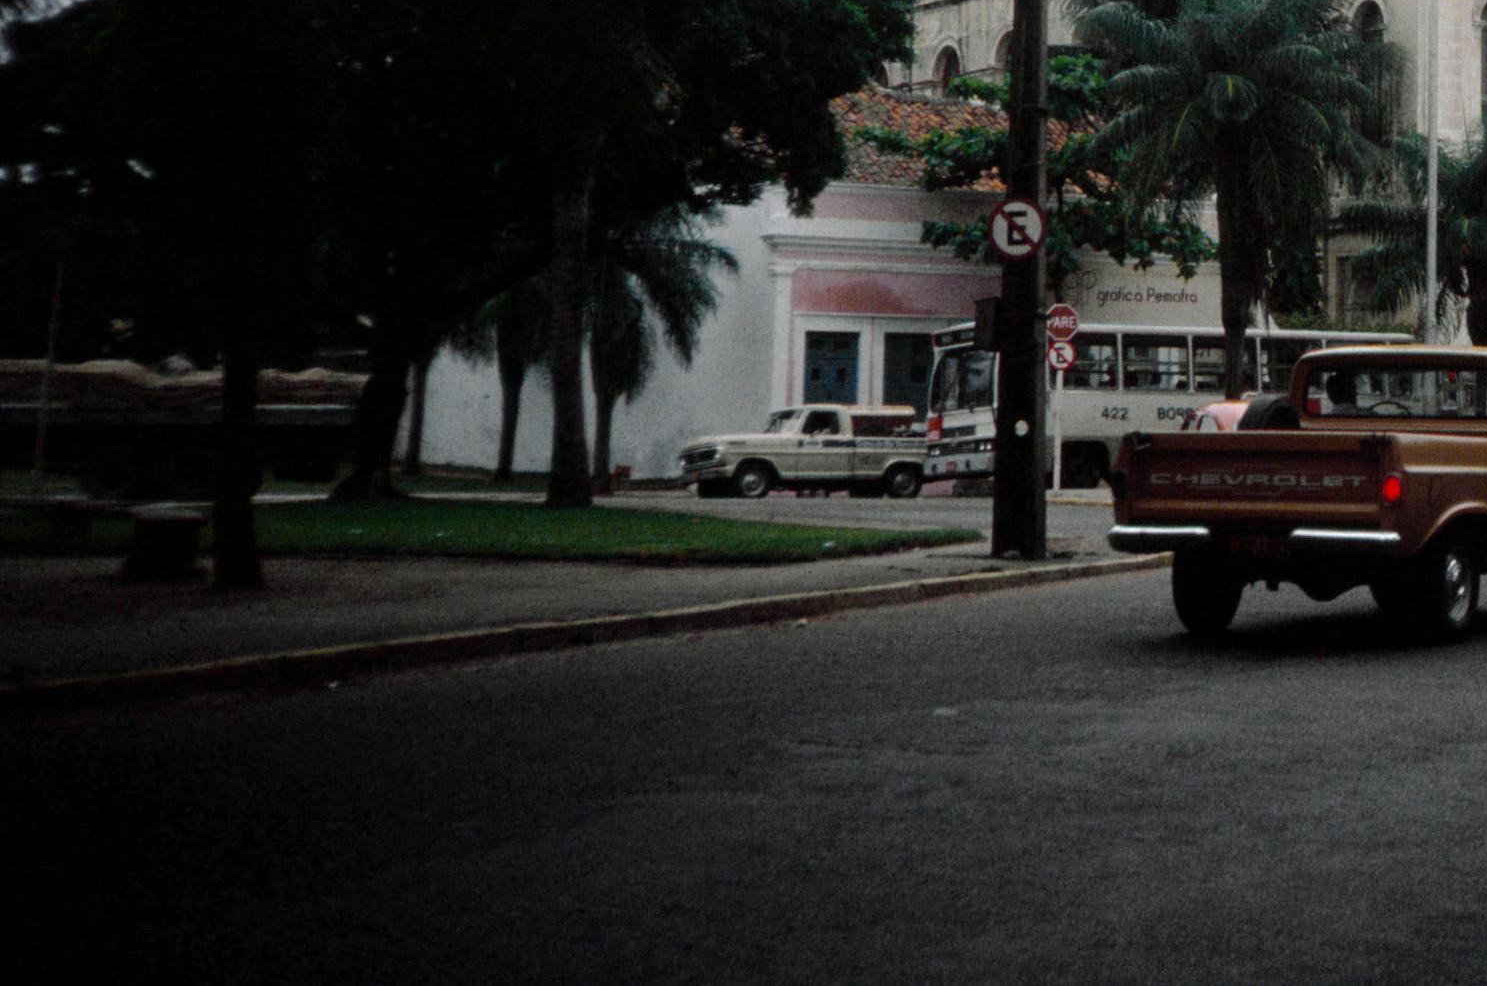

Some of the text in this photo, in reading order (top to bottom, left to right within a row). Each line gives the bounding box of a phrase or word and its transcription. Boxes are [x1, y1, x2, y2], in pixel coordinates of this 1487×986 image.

[1047, 317, 1076, 329] PARE
[1101, 405, 1129, 420] 422
[1149, 472, 1368, 488] CHEVROLET
